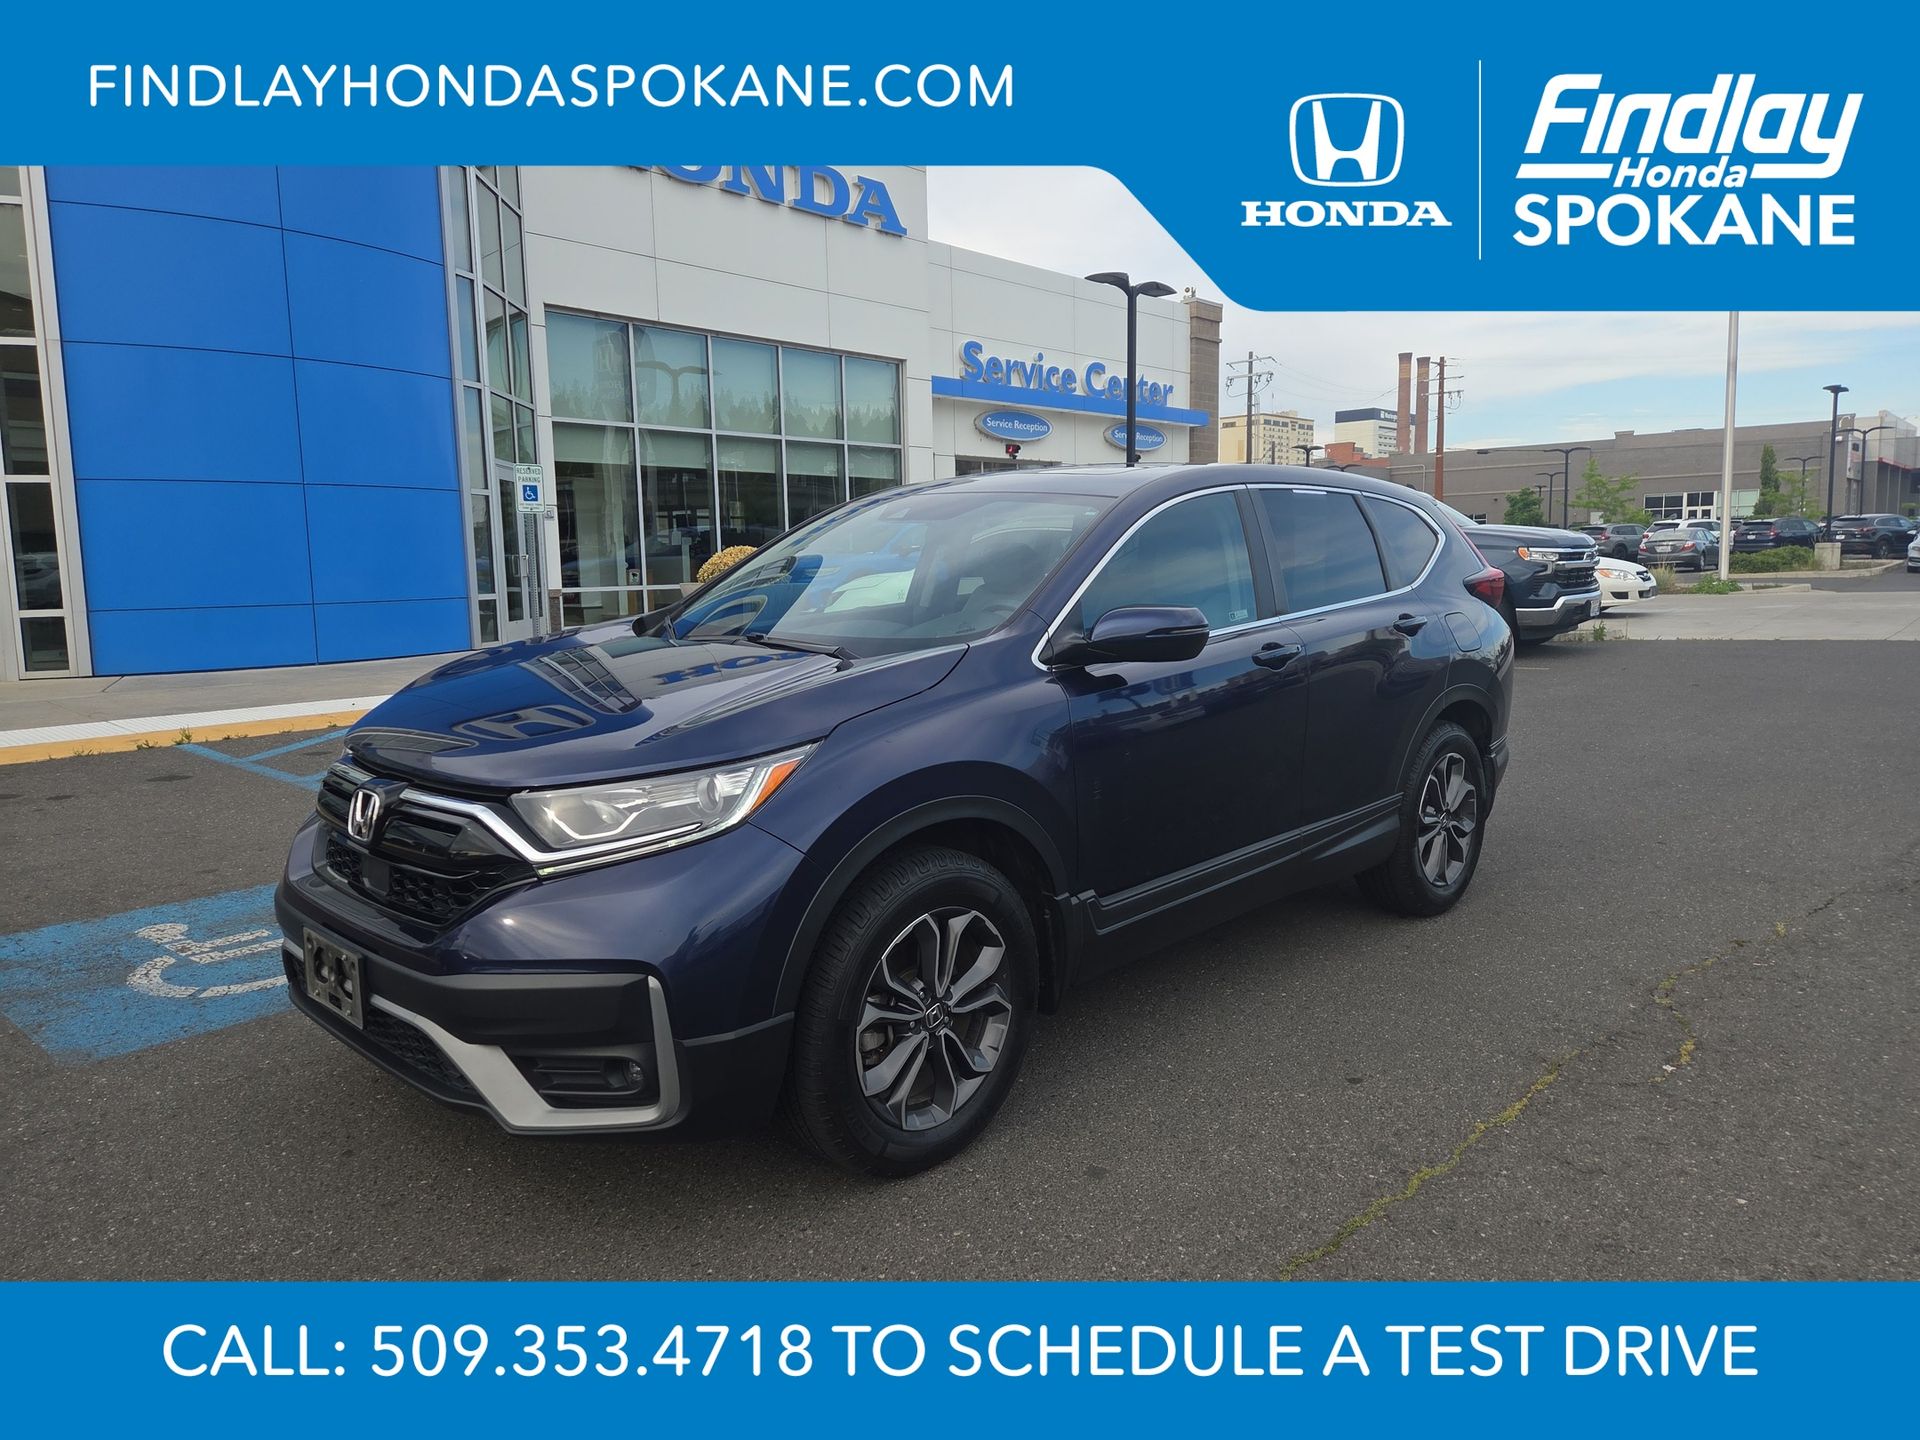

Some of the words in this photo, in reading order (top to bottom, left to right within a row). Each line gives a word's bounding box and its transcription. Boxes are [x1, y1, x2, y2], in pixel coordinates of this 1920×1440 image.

[628, 165, 908, 236] NDA
[960, 340, 1077, 393] Service
[986, 417, 1013, 428] Service
[1014, 420, 1048, 433] Reception
[516, 467, 541, 475] RESERVED
